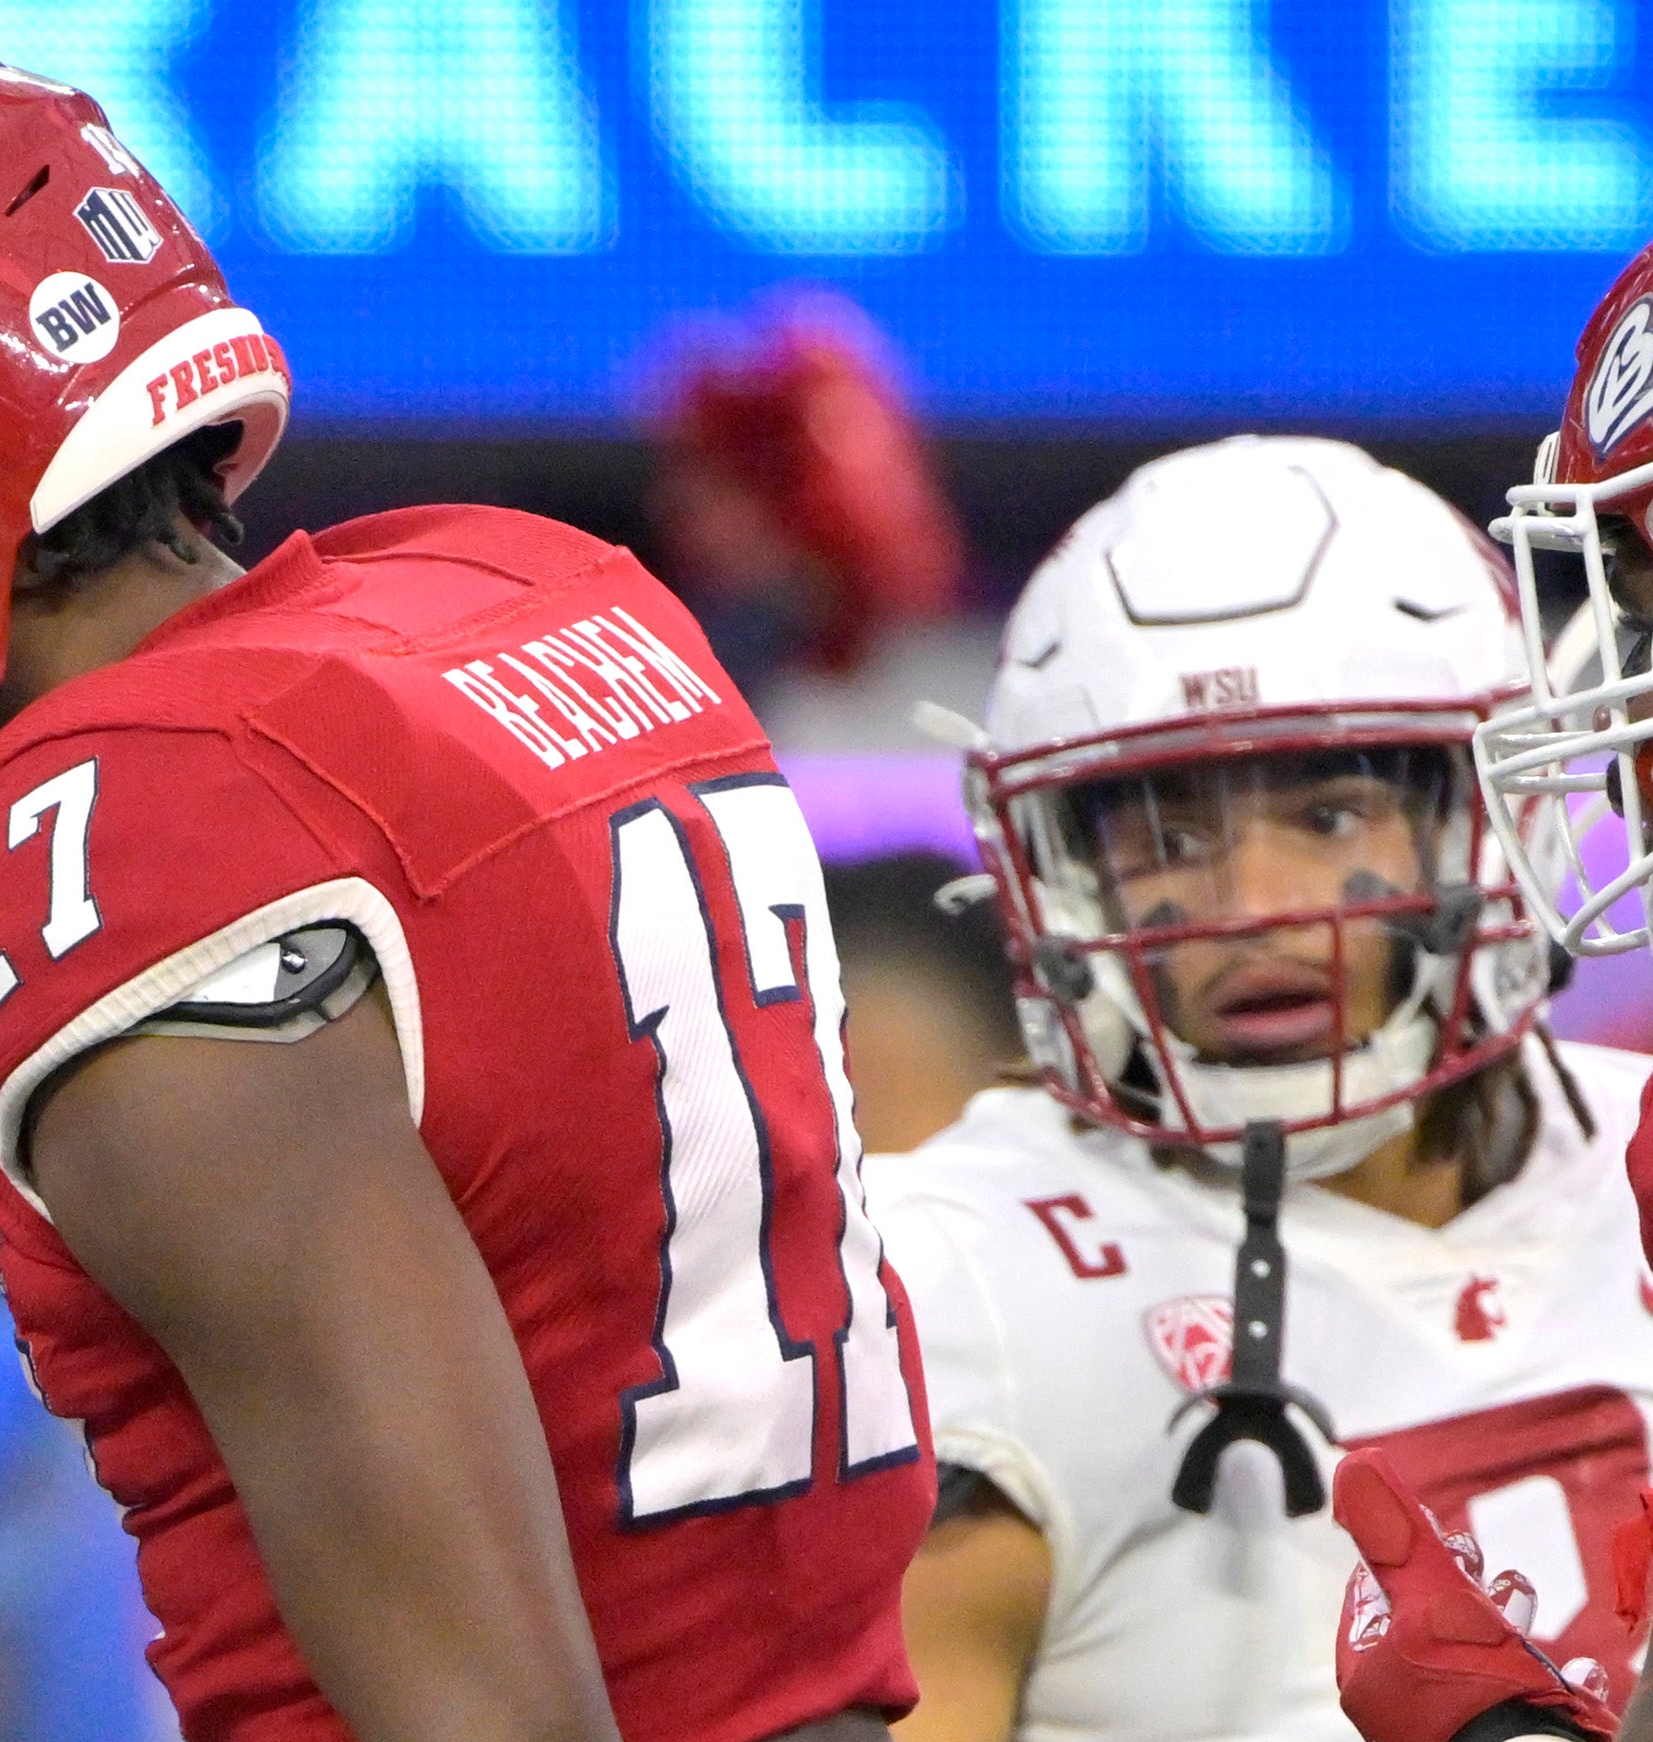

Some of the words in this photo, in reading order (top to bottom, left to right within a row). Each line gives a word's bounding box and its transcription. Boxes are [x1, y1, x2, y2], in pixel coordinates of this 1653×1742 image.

[35, 281, 112, 354] BW
[146, 333, 270, 426] FRESNO
[441, 606, 722, 770] BEACHEM
[1179, 668, 1259, 707] WSU
[610, 772, 919, 1531] 17
[1024, 1194, 1131, 1280] C
